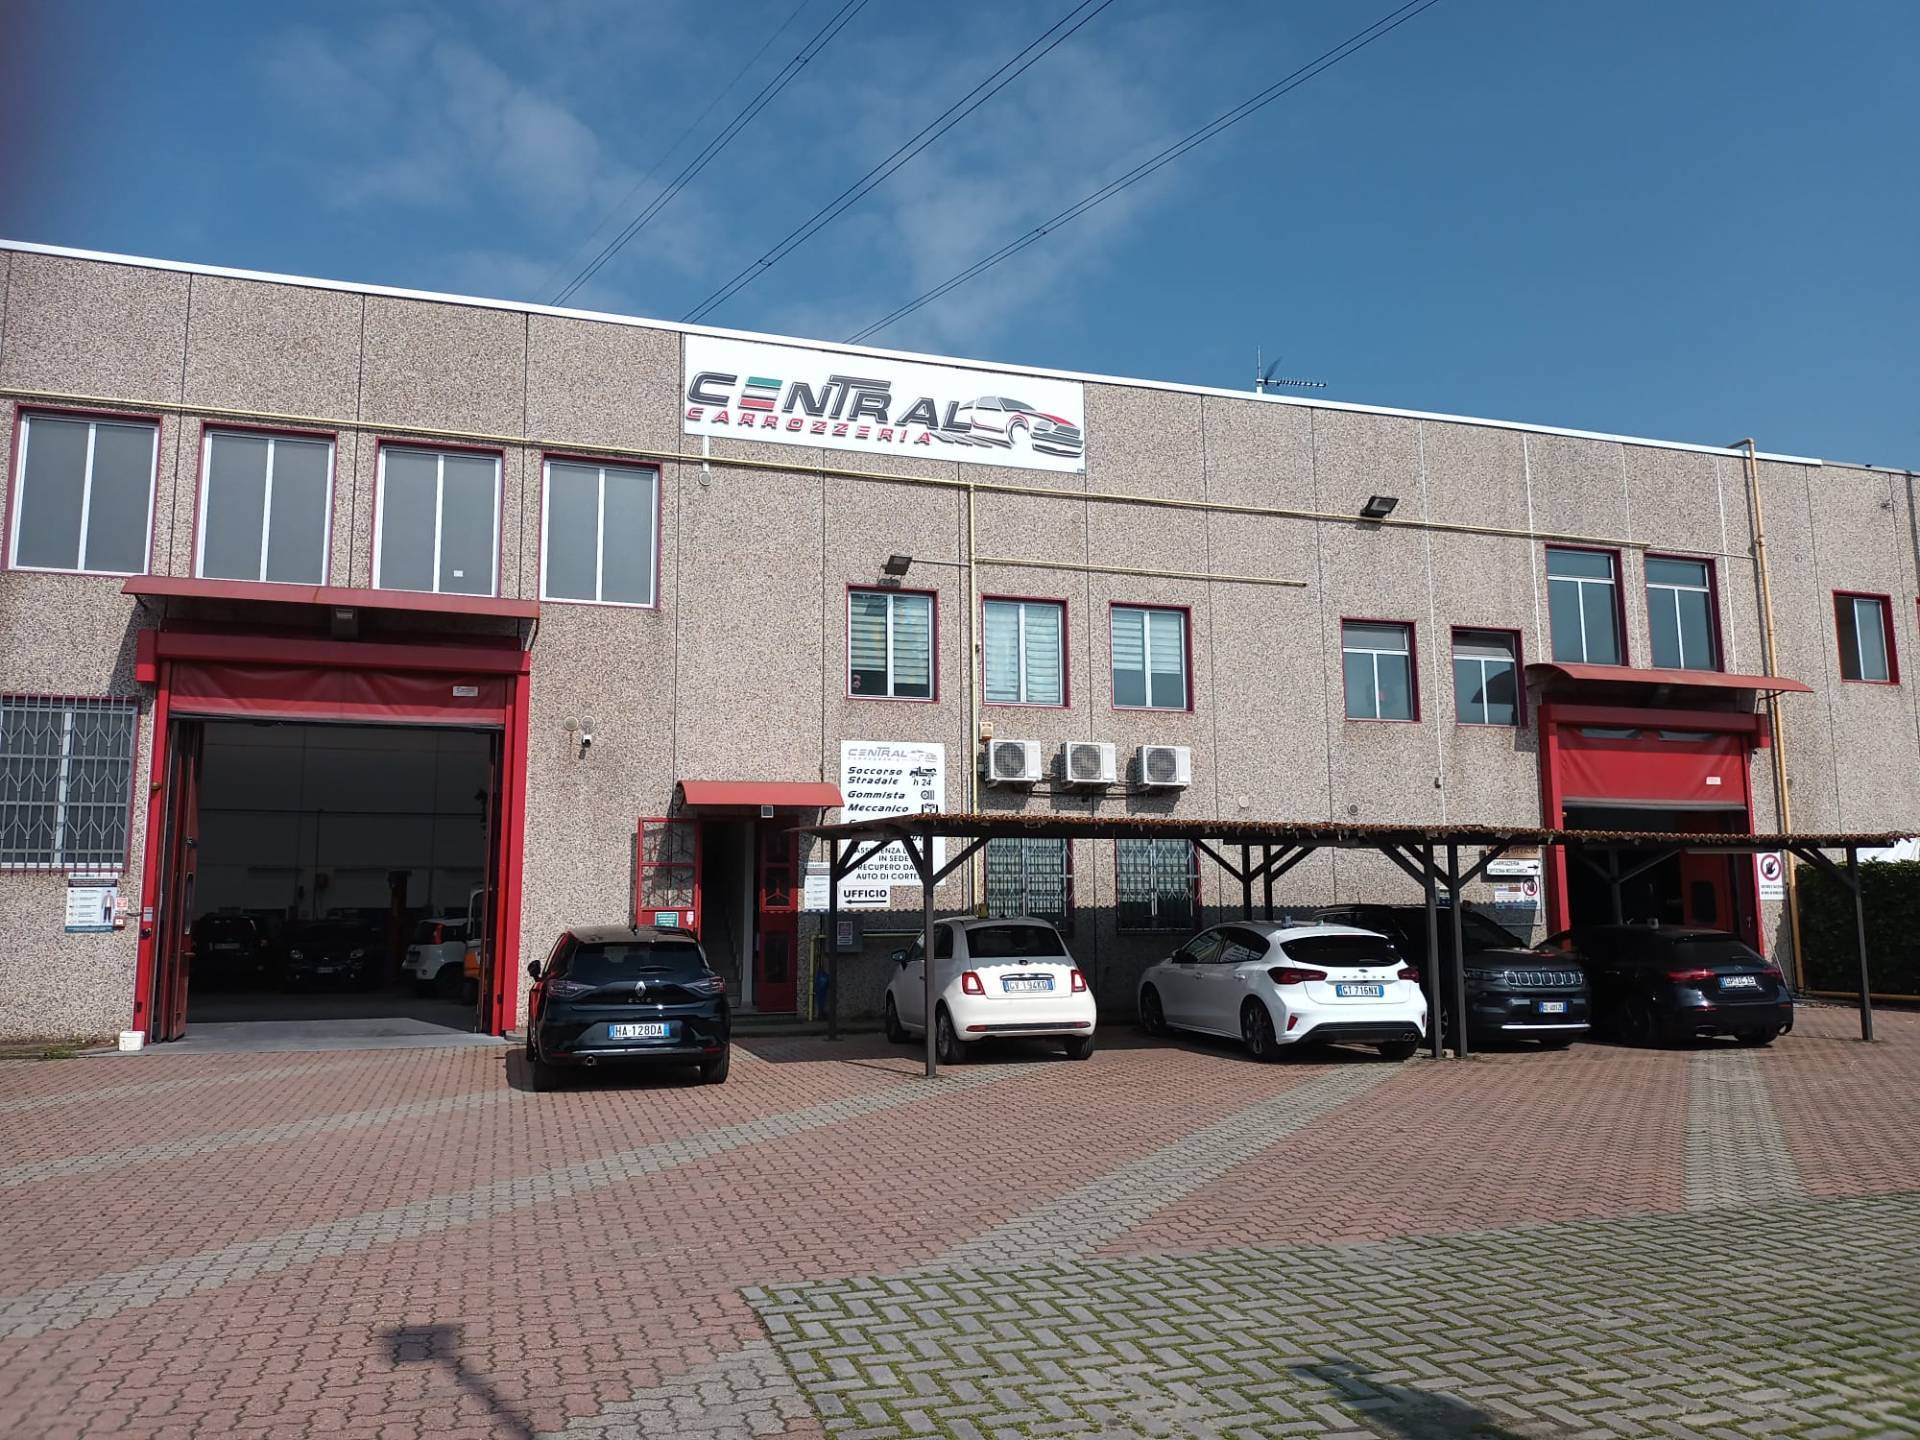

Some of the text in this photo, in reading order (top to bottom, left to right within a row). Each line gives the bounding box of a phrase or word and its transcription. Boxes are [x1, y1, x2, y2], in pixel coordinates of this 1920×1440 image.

[686, 371, 973, 433] CENTRAL
[685, 407, 932, 446] CARROZZERIA
[848, 746, 908, 758] CENTRAL
[847, 766, 903, 776] Soccorso
[847, 776, 899, 785] Stradale
[913, 778, 932, 787] h 24
[847, 790, 906, 800] Gommista
[847, 803, 909, 813] Meccanico
[858, 863, 901, 871] RECUPERO
[843, 889, 888, 898] UFFICIO
[615, 1024, 663, 1037] HA 128DA
